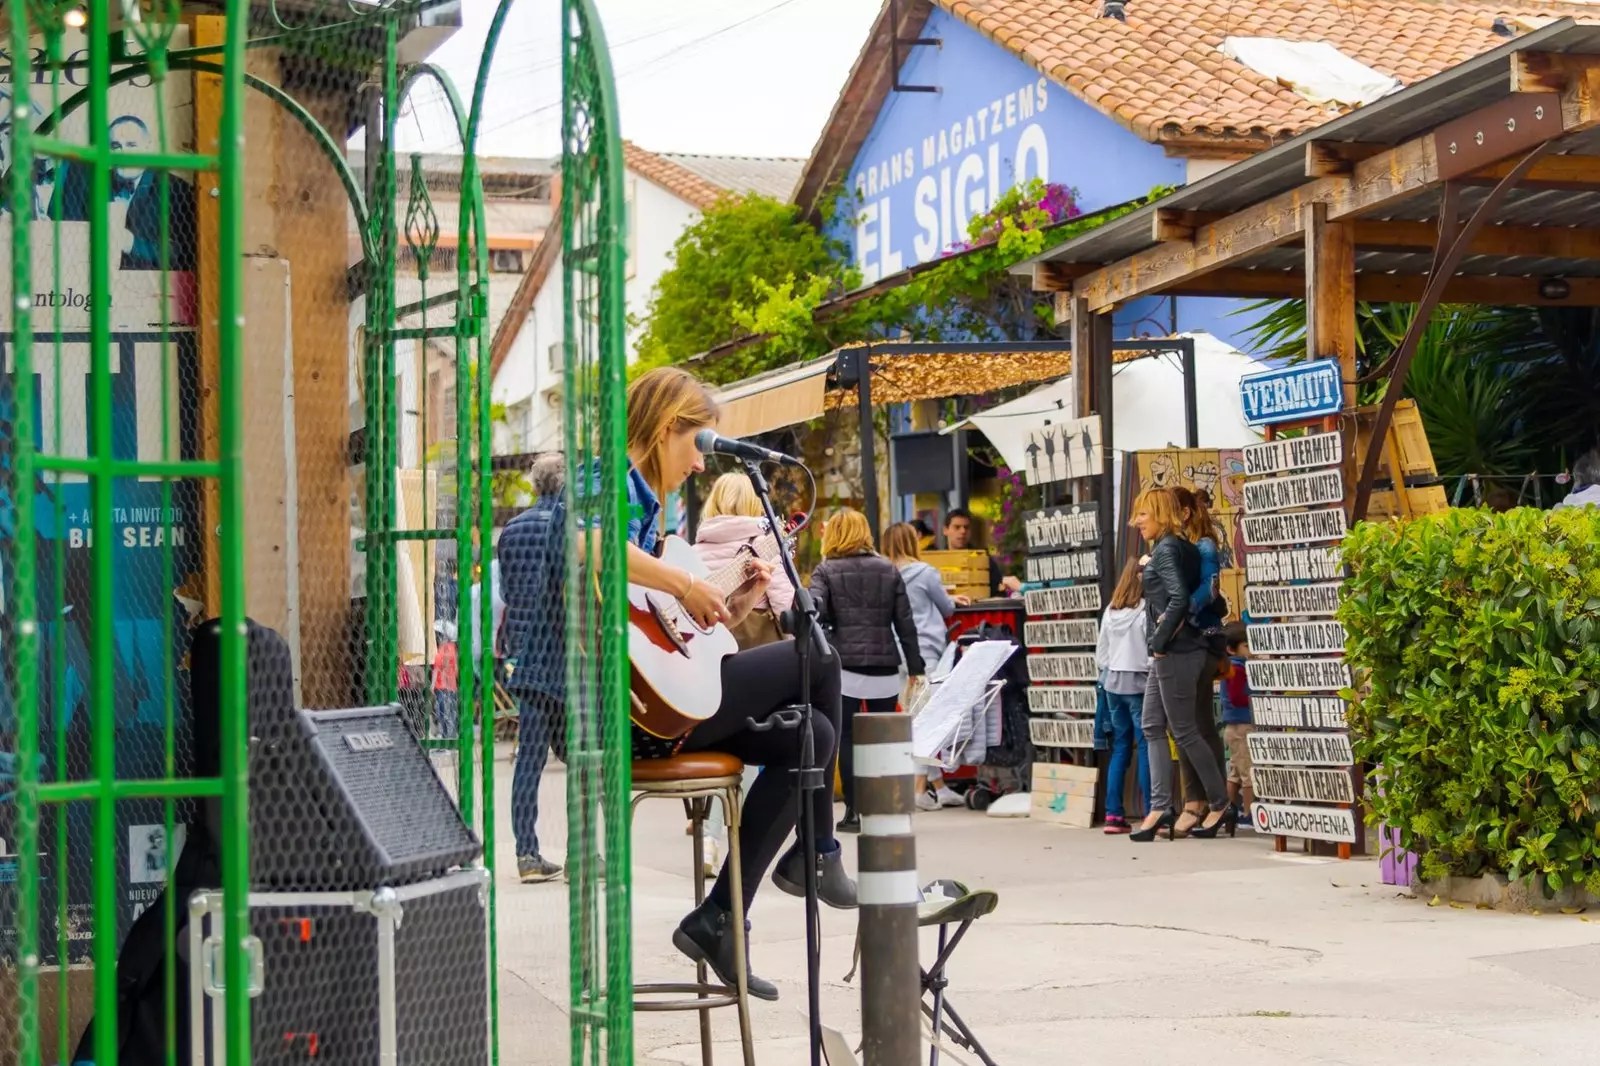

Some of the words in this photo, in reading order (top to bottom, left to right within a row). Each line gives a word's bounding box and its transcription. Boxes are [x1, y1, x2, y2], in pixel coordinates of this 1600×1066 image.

[856, 148, 914, 198] GRANS
[923, 77, 1049, 169] MAGATZEMS
[856, 197, 903, 290] EL
[31, 287, 113, 312] ntolog
[1244, 369, 1333, 416] VERMUT
[1245, 445, 1280, 474] SALUT
[1283, 443, 1288, 467] I
[1290, 435, 1337, 466] VERMUT
[1245, 482, 1278, 511] SMOKE
[1277, 480, 1291, 507] ON
[1290, 478, 1309, 504] THE
[1308, 473, 1340, 502] WATER
[131, 507, 183, 524] INVITDO
[1245, 517, 1285, 543] WELCOME
[1285, 515, 1296, 540] TO
[1295, 514, 1312, 539] THE
[1312, 511, 1342, 537] JUNGLE
[123, 526, 185, 548] SEAN
[1053, 555, 1071, 579] NEED
[1079, 552, 1098, 577] LOVE
[1246, 552, 1280, 582] RIDERS
[1280, 549, 1293, 580] ON
[1292, 549, 1310, 580] THE
[1031, 591, 1050, 612] WANT
[1050, 589, 1060, 611] TO
[1059, 587, 1082, 610] BREAK
[1082, 586, 1099, 608] FREE
[1249, 588, 1293, 613] ABSOLUTE
[1249, 627, 1275, 651] WALK
[1275, 627, 1286, 650] ON
[1285, 626, 1302, 650] THE
[1302, 624, 1326, 649] WILD
[1248, 663, 1275, 687] WISH
[1275, 662, 1295, 687] YOU
[1295, 662, 1321, 687] WERE
[1321, 662, 1347, 686] HERE
[1062, 691, 1073, 710] ME
[1073, 691, 1096, 710] DOWN
[1251, 697, 1303, 727] HIGHWAY
[1303, 697, 1321, 728] TO
[1249, 737, 1268, 760] IT'S
[1267, 737, 1291, 760] ONLY
[1324, 738, 1350, 762] ROLL
[1254, 768, 1301, 798] STAIRWAY
[1299, 769, 1314, 799] TO
[1313, 770, 1351, 802] HEAVEN
[1256, 805, 1351, 836] QUADROPHENIA
